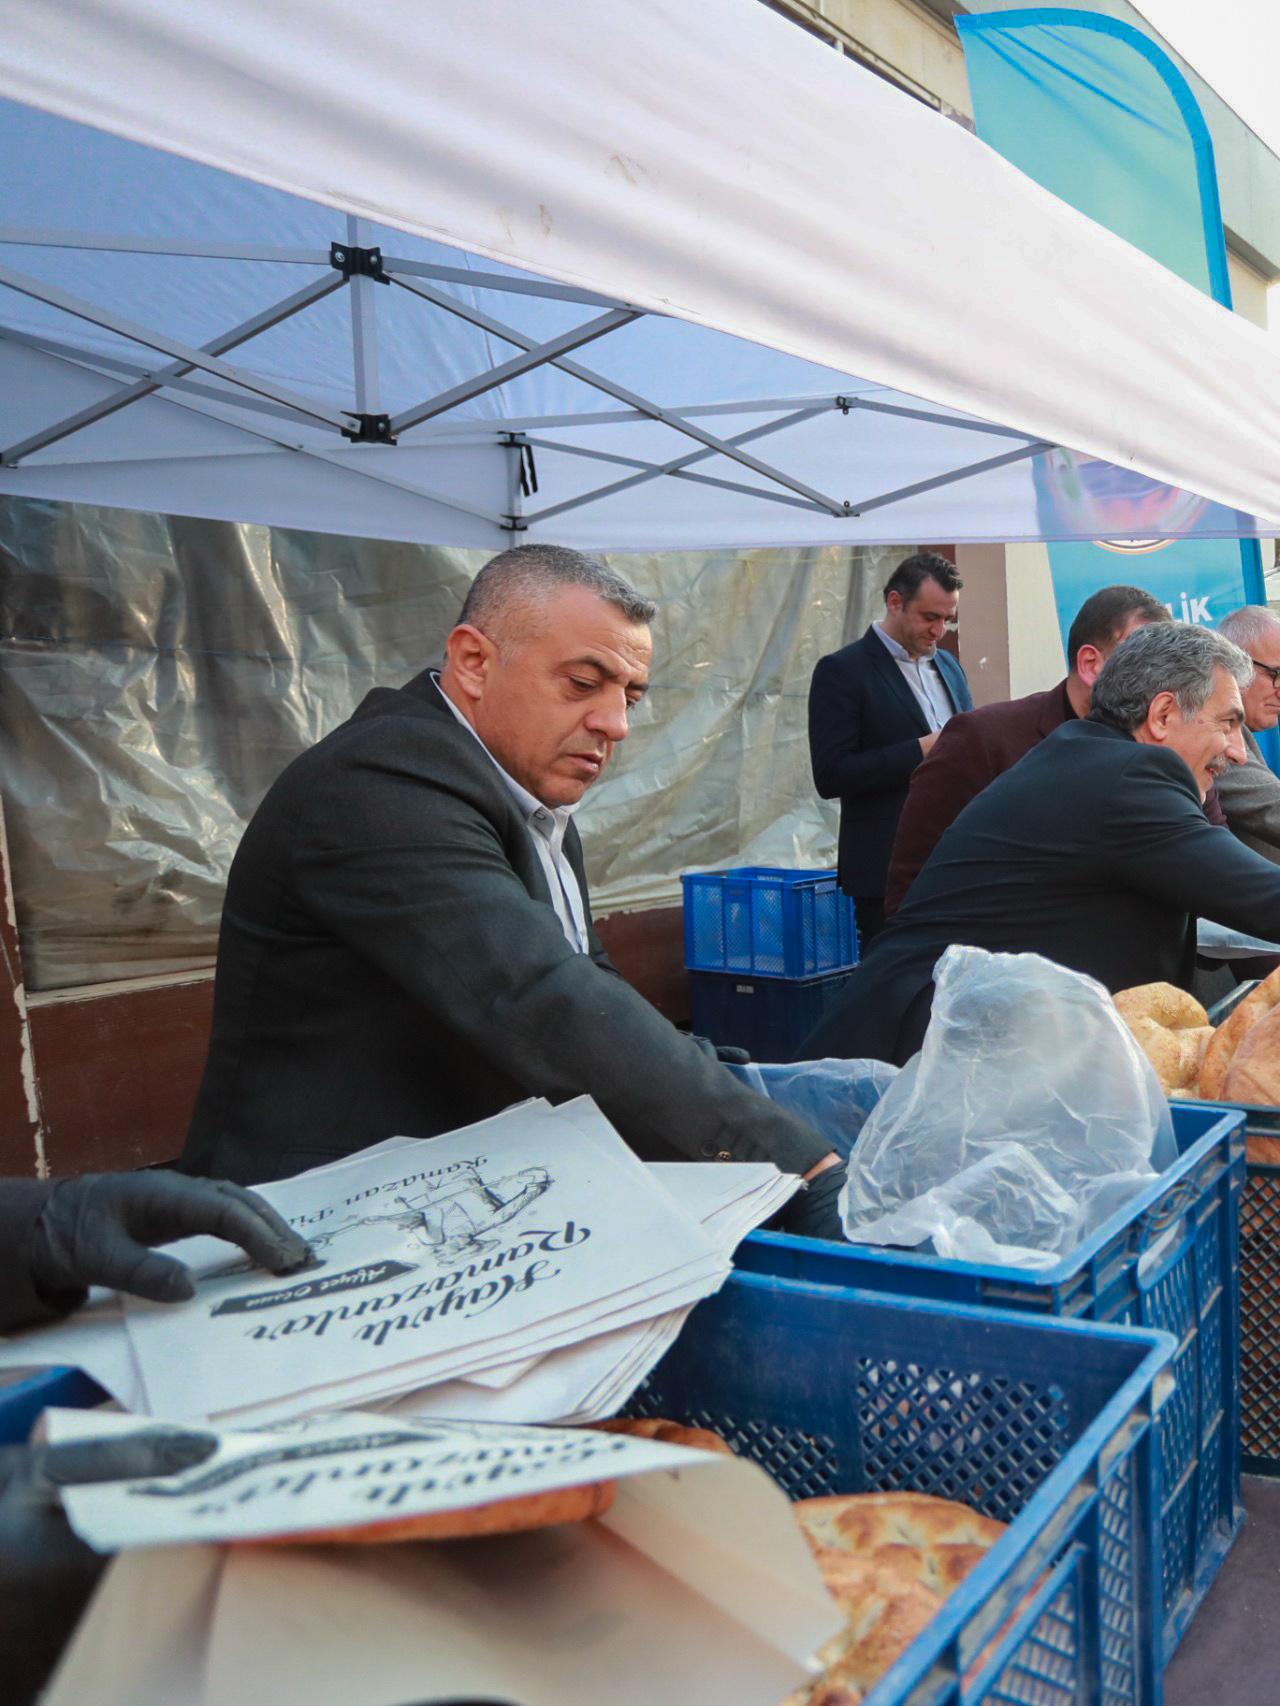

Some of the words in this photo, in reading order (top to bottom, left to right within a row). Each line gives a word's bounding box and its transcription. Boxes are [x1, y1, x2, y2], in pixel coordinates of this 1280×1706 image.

[342, 1155, 488, 1207] Ramazan
[245, 1221, 591, 1341] Ramazanlar
[352, 1260, 561, 1347] Hayırlı
